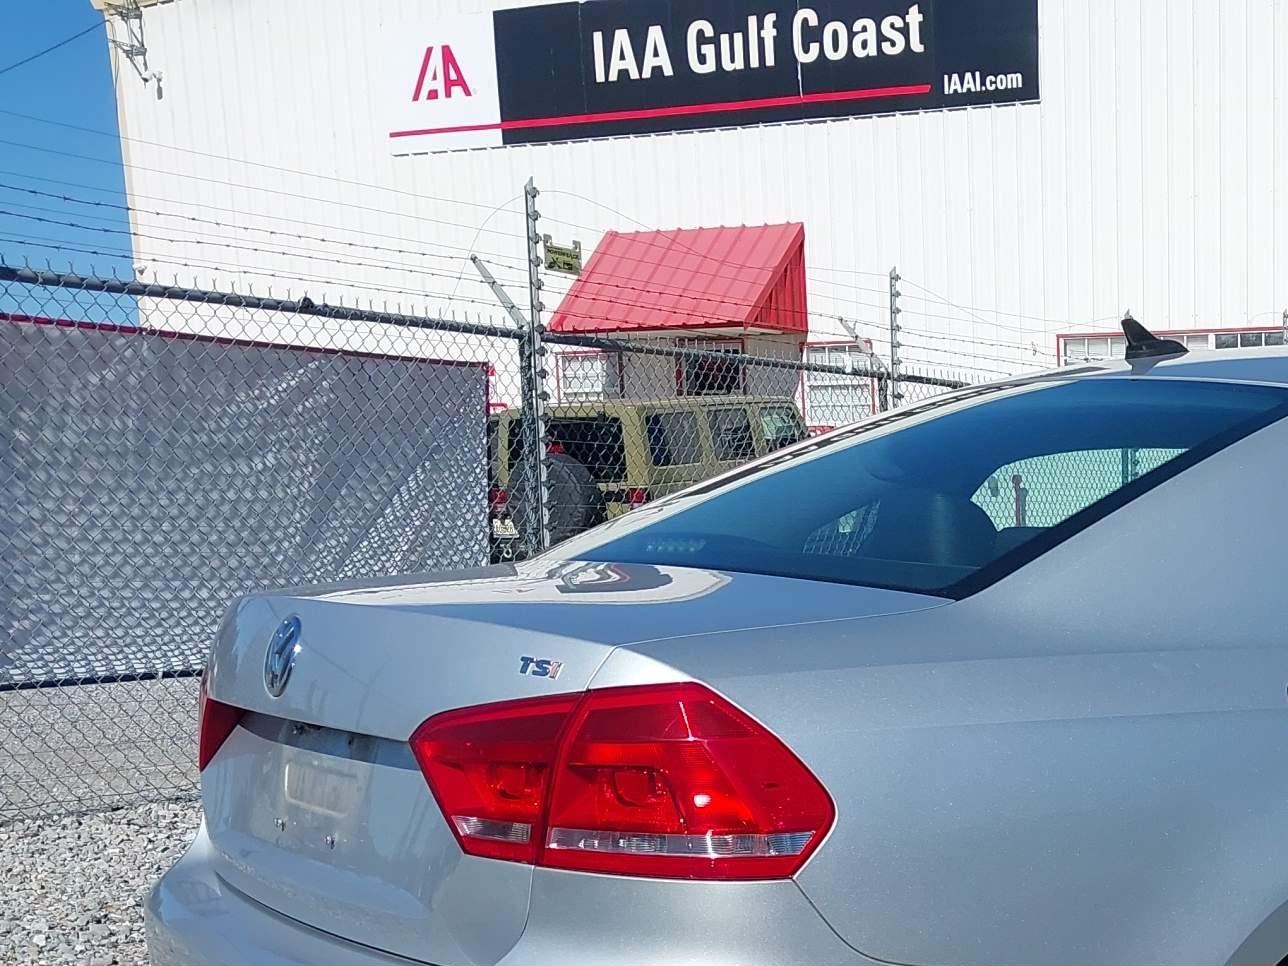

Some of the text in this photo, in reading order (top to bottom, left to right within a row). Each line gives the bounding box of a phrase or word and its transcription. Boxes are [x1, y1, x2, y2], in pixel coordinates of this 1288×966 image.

[593, 3, 925, 83] IAA Gulf Coast
[943, 70, 1023, 95] IAAI.com
